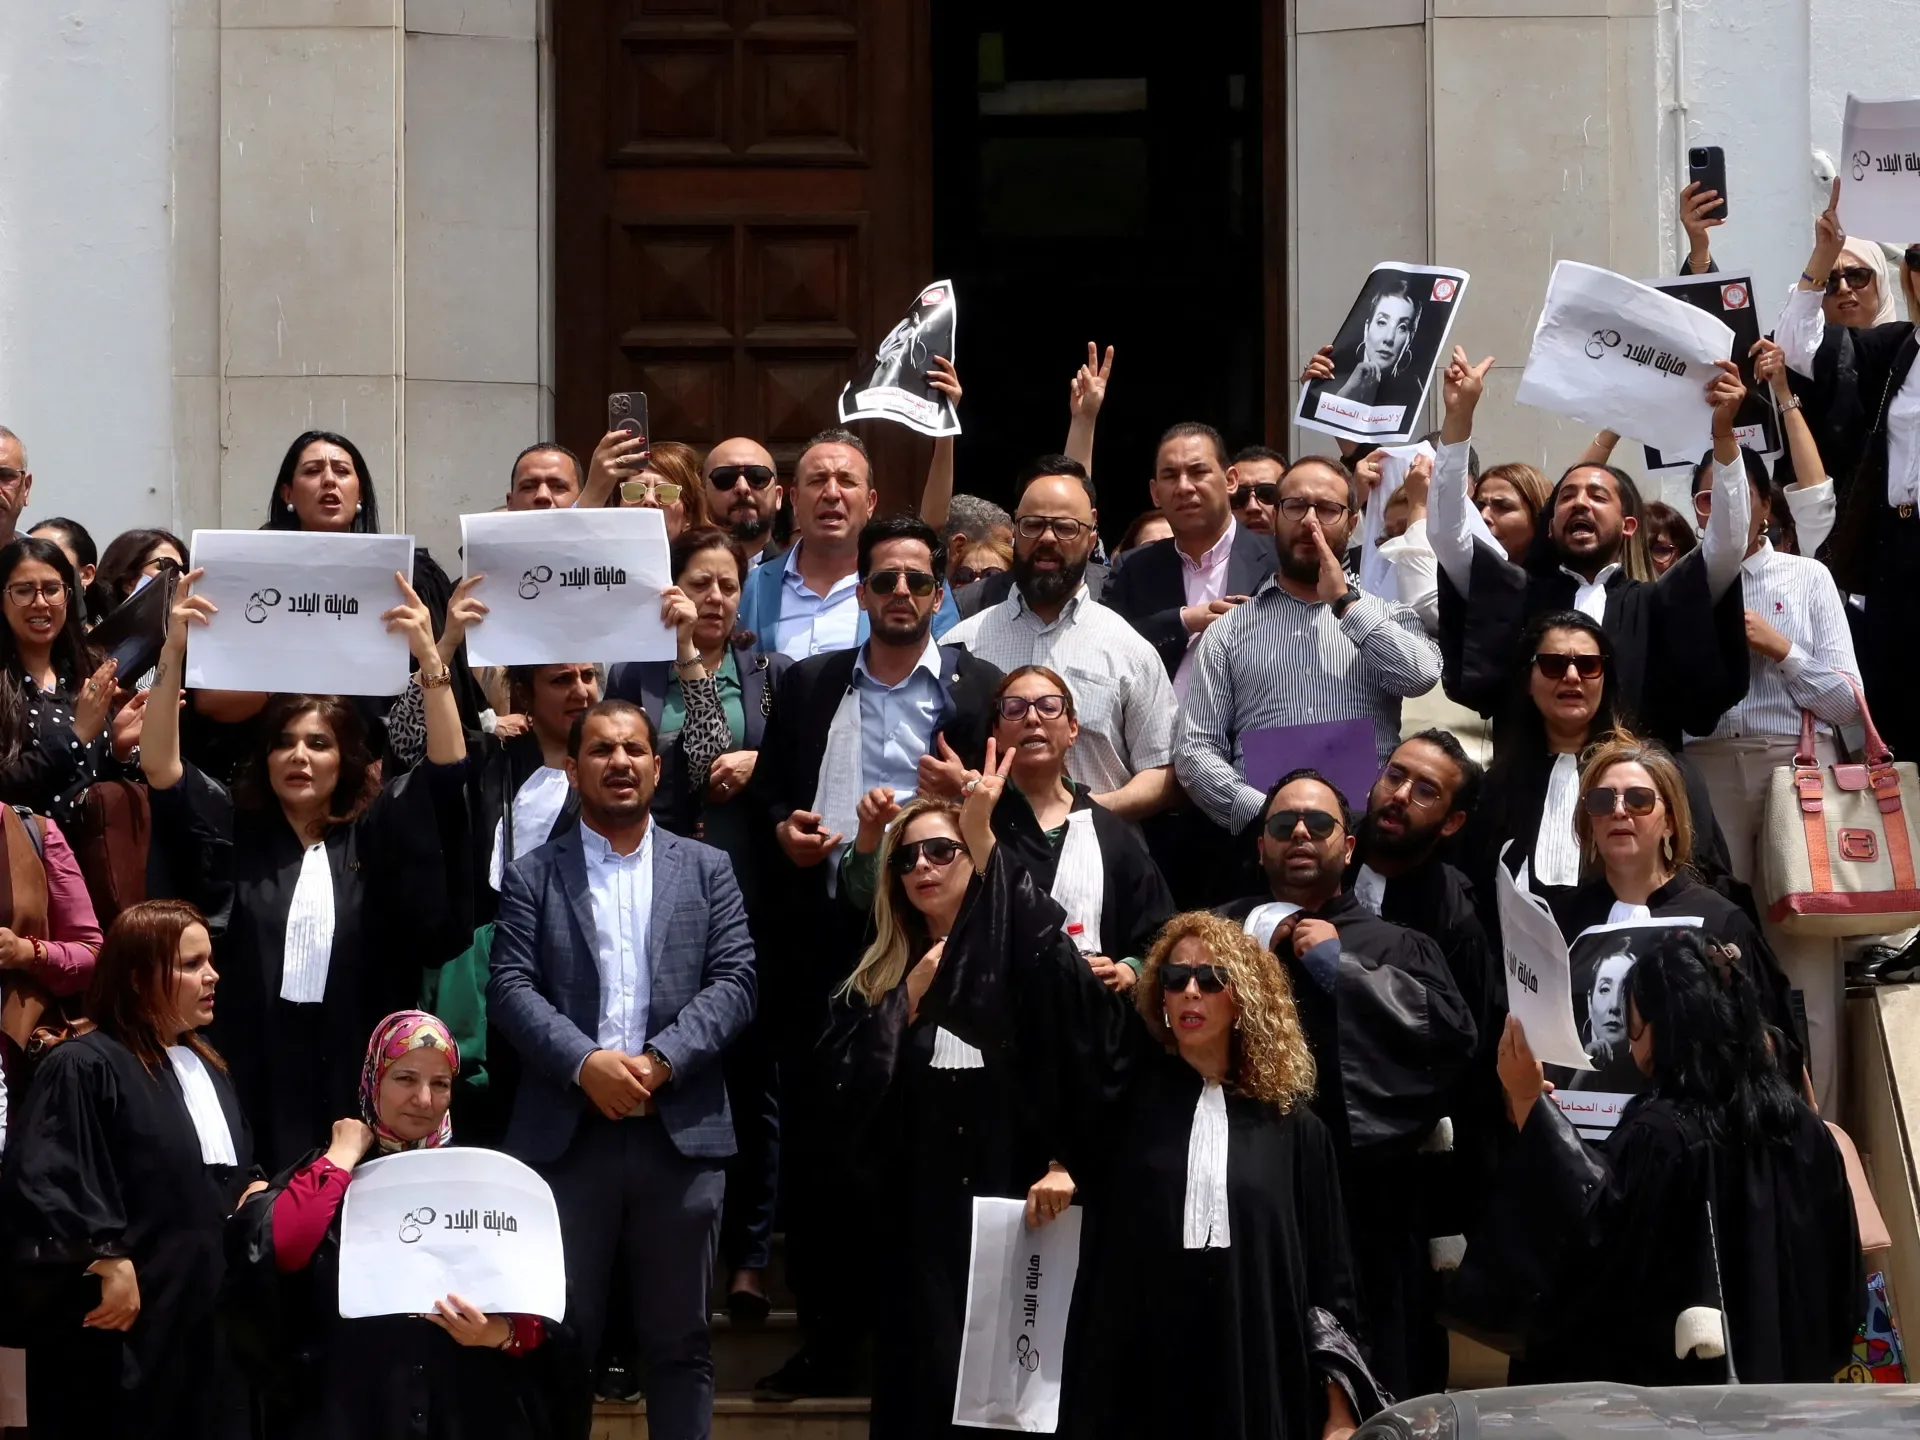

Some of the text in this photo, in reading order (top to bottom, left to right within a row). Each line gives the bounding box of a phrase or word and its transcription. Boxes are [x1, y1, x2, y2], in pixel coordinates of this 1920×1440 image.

[1876, 151, 1920, 177] يلة البلاد
[1622, 343, 1687, 378] هايلة البلاد
[1320, 400, 1360, 420] المحاماة
[559, 565, 626, 591] هايلة البلاد
[287, 592, 359, 621] هايلة البلاد
[1517, 960, 1538, 995] هايلة
[444, 1208, 518, 1237] هايلة البلاد
[1023, 1254, 1043, 1328] هايلة البلاد
